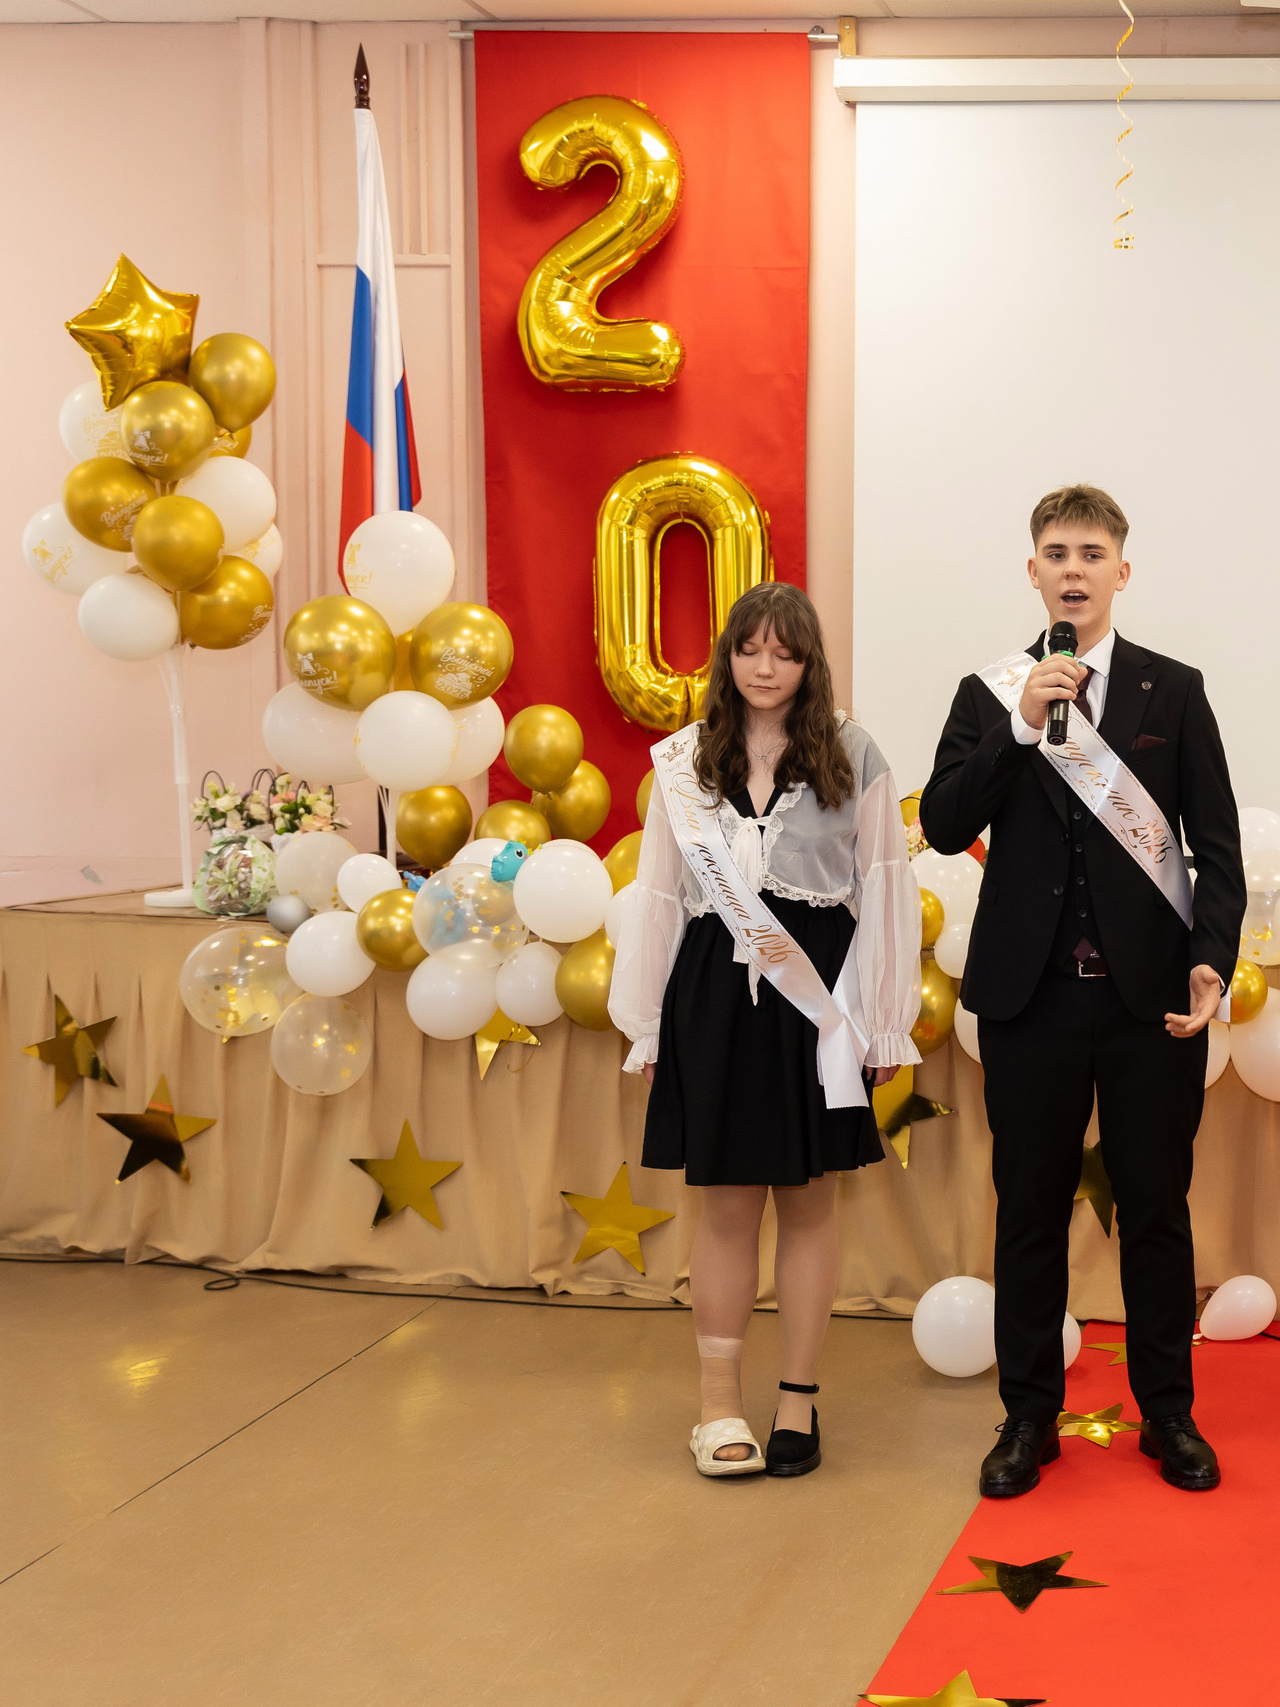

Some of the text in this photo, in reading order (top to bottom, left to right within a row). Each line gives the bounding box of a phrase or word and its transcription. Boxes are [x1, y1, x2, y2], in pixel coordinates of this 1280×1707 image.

[517, 94, 686, 393] 2
[593, 451, 775, 735] 0
[440, 646, 496, 678] Выпускной
[1128, 819, 1174, 864] 2026
[742, 924, 800, 963] 2026
